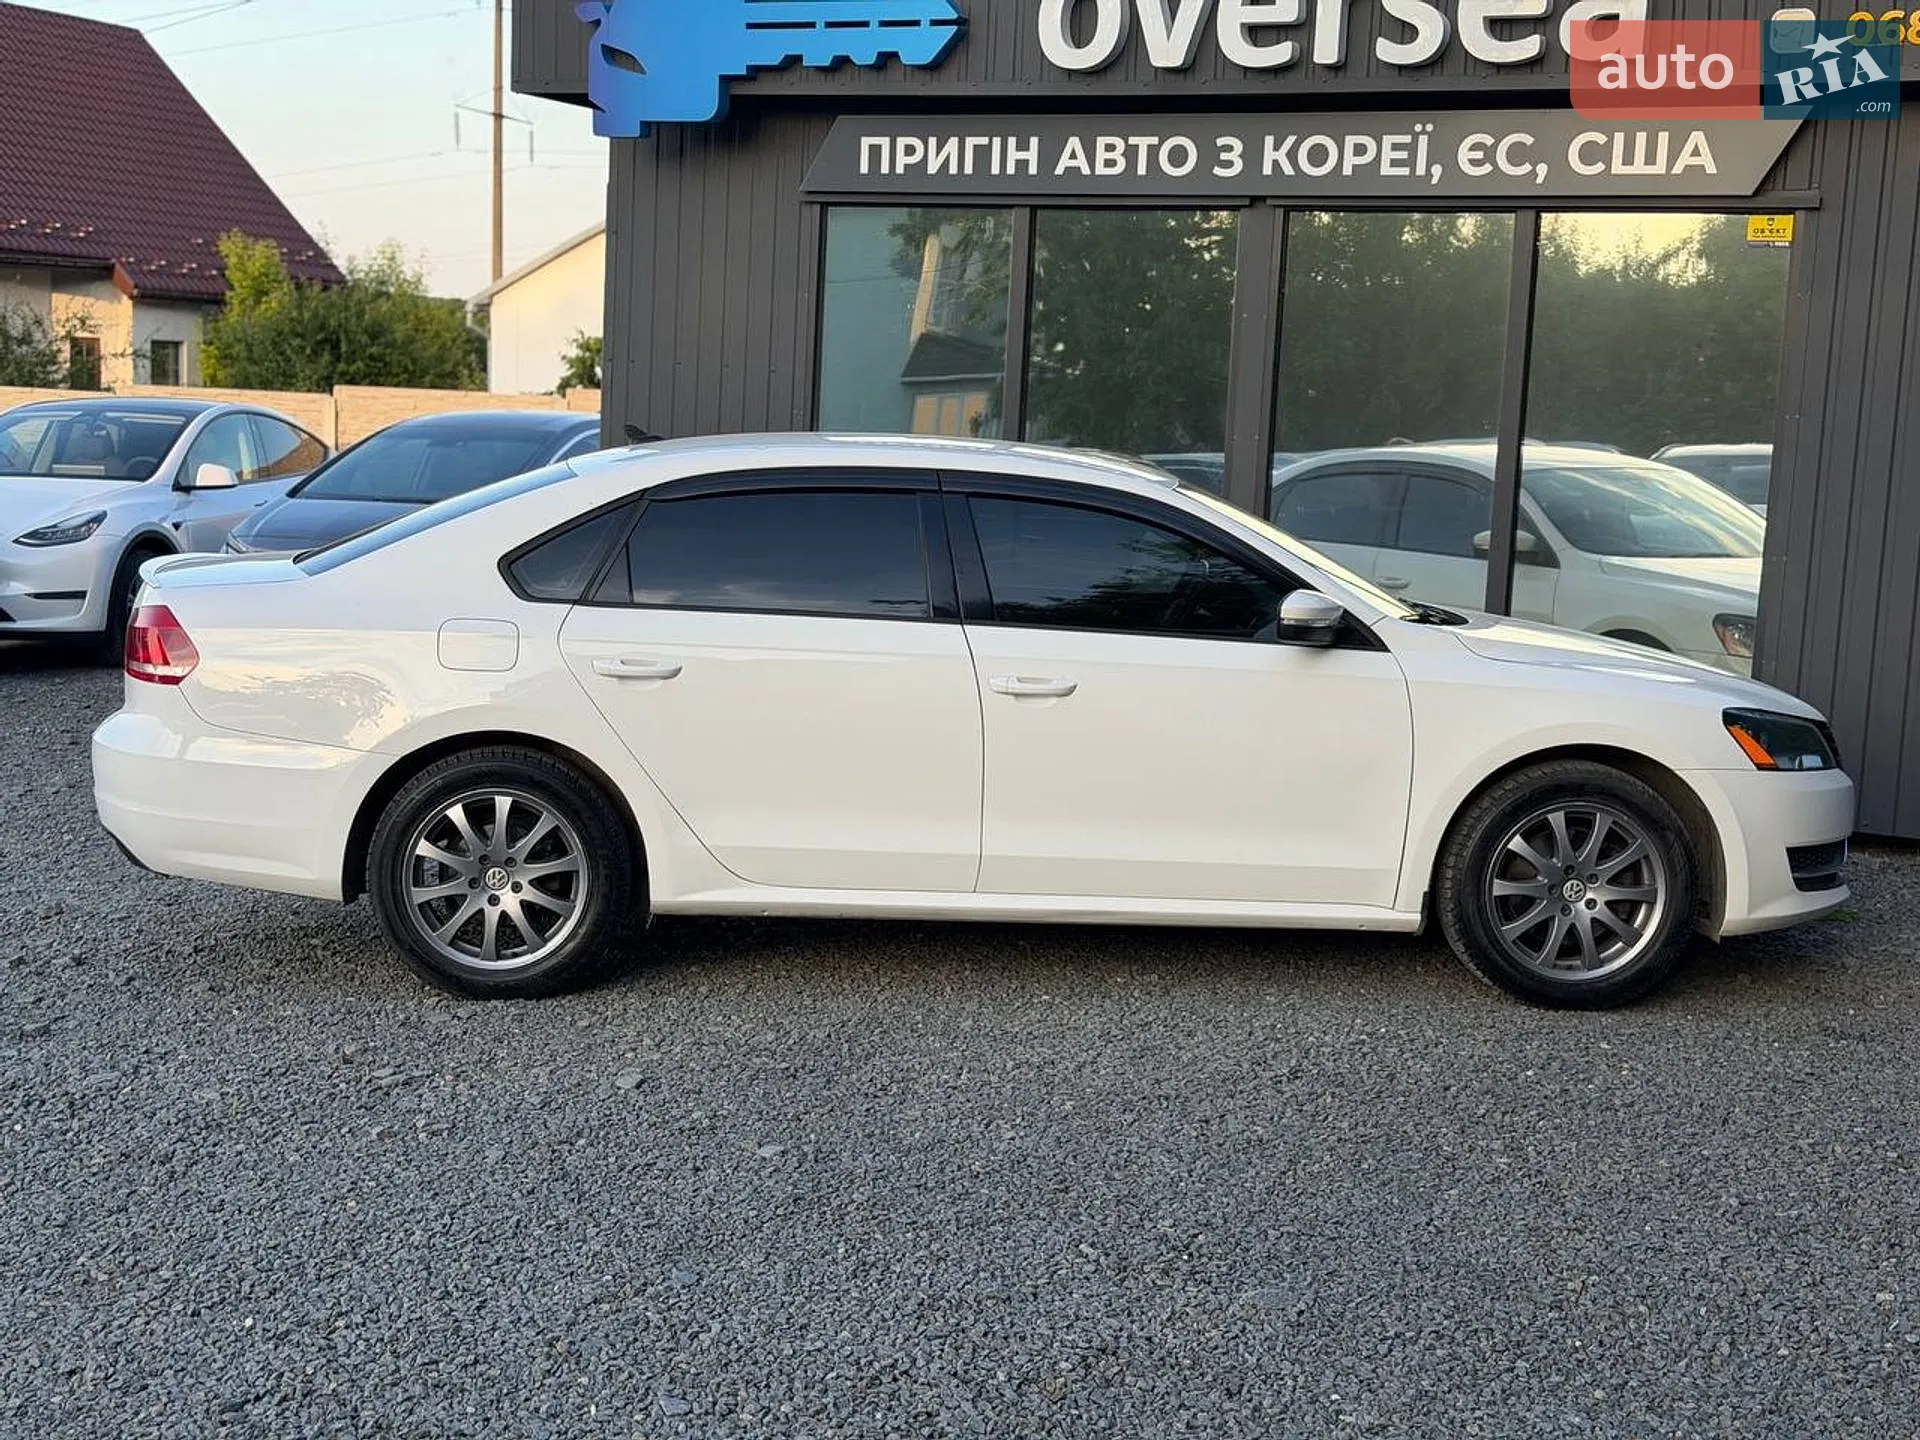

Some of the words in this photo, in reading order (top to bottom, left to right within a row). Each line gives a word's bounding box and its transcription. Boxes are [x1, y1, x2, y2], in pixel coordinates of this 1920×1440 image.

[859, 136, 1039, 175] ПРИГІН
[1054, 135, 1198, 177] АВТО
[1262, 123, 1443, 185] КОРЕЇ,
[1457, 132, 1549, 185] ЄС,
[1567, 130, 1718, 176] США
